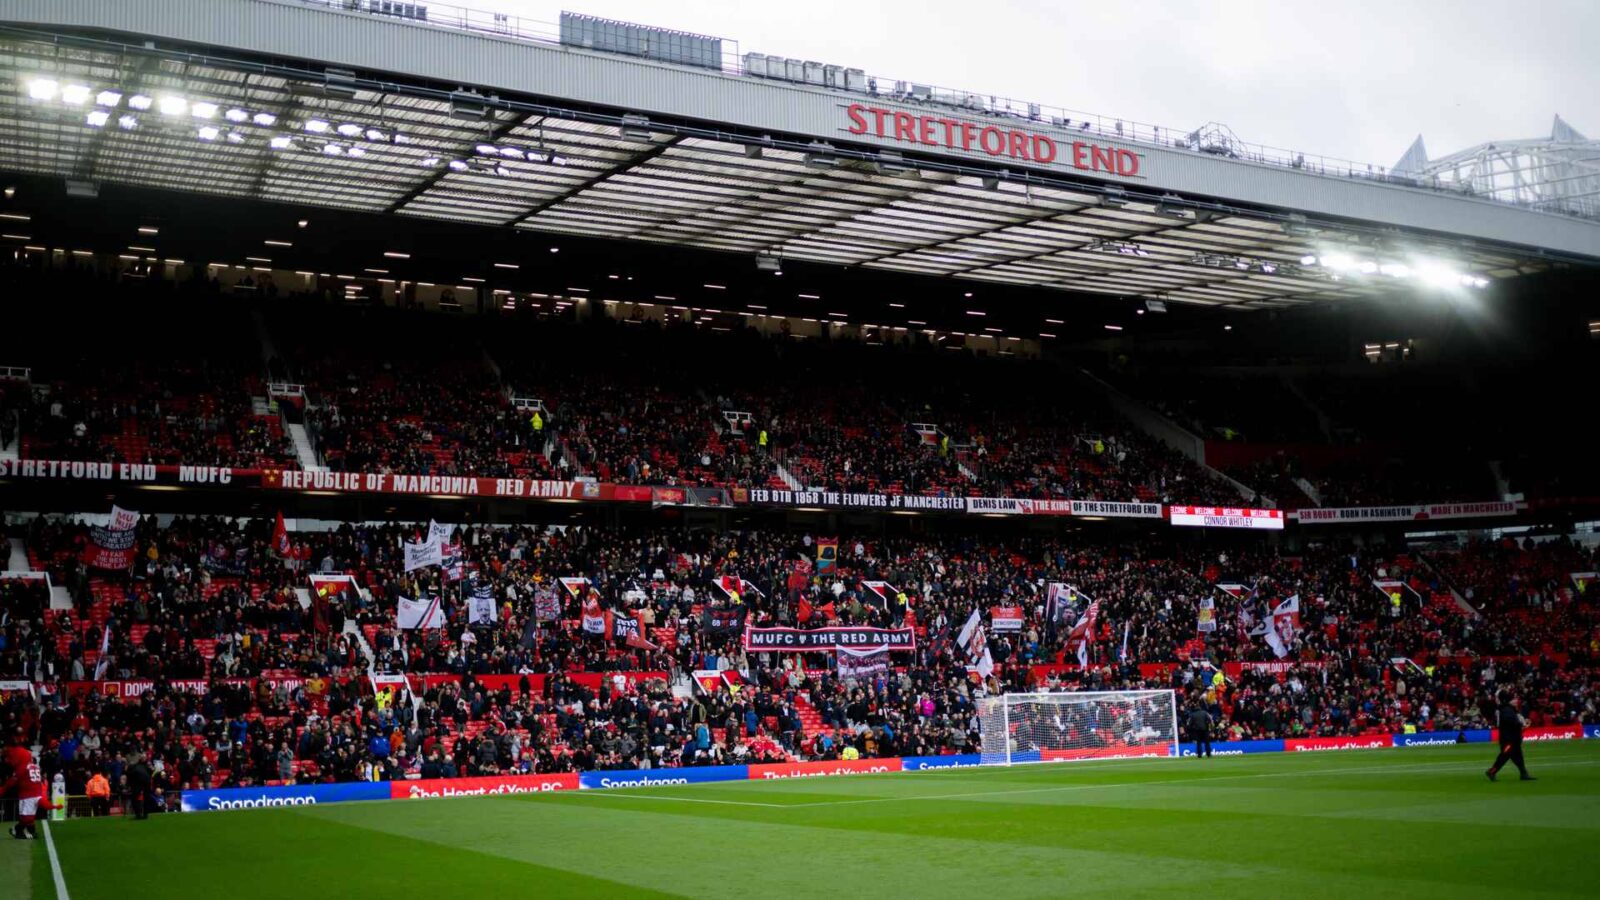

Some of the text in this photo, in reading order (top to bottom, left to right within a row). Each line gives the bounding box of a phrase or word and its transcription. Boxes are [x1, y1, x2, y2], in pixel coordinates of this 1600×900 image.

[847, 103, 1139, 177] STRETFORD END
[119, 463, 156, 481] END
[179, 465, 232, 484] MUFC
[366, 473, 386, 491] OF
[751, 490, 769, 502] FEB
[822, 492, 840, 505] THE
[842, 493, 887, 507] FLOWERS
[904, 495, 964, 509] MANCHESTER
[973, 499, 1017, 510] DENIS LAW
[1035, 501, 1070, 511] THE KING
[1073, 503, 1158, 514] OF THE STRETFORD END
[1431, 502, 1514, 515] MADE IN MANCHESTER
[1300, 510, 1312, 520] SIR
[1340, 509, 1360, 519] BORN
[1361, 508, 1369, 518] IN
[1203, 516, 1254, 527] CONNOR WHITLEY
[752, 633, 910, 644] MUFC THE RED ARMY
